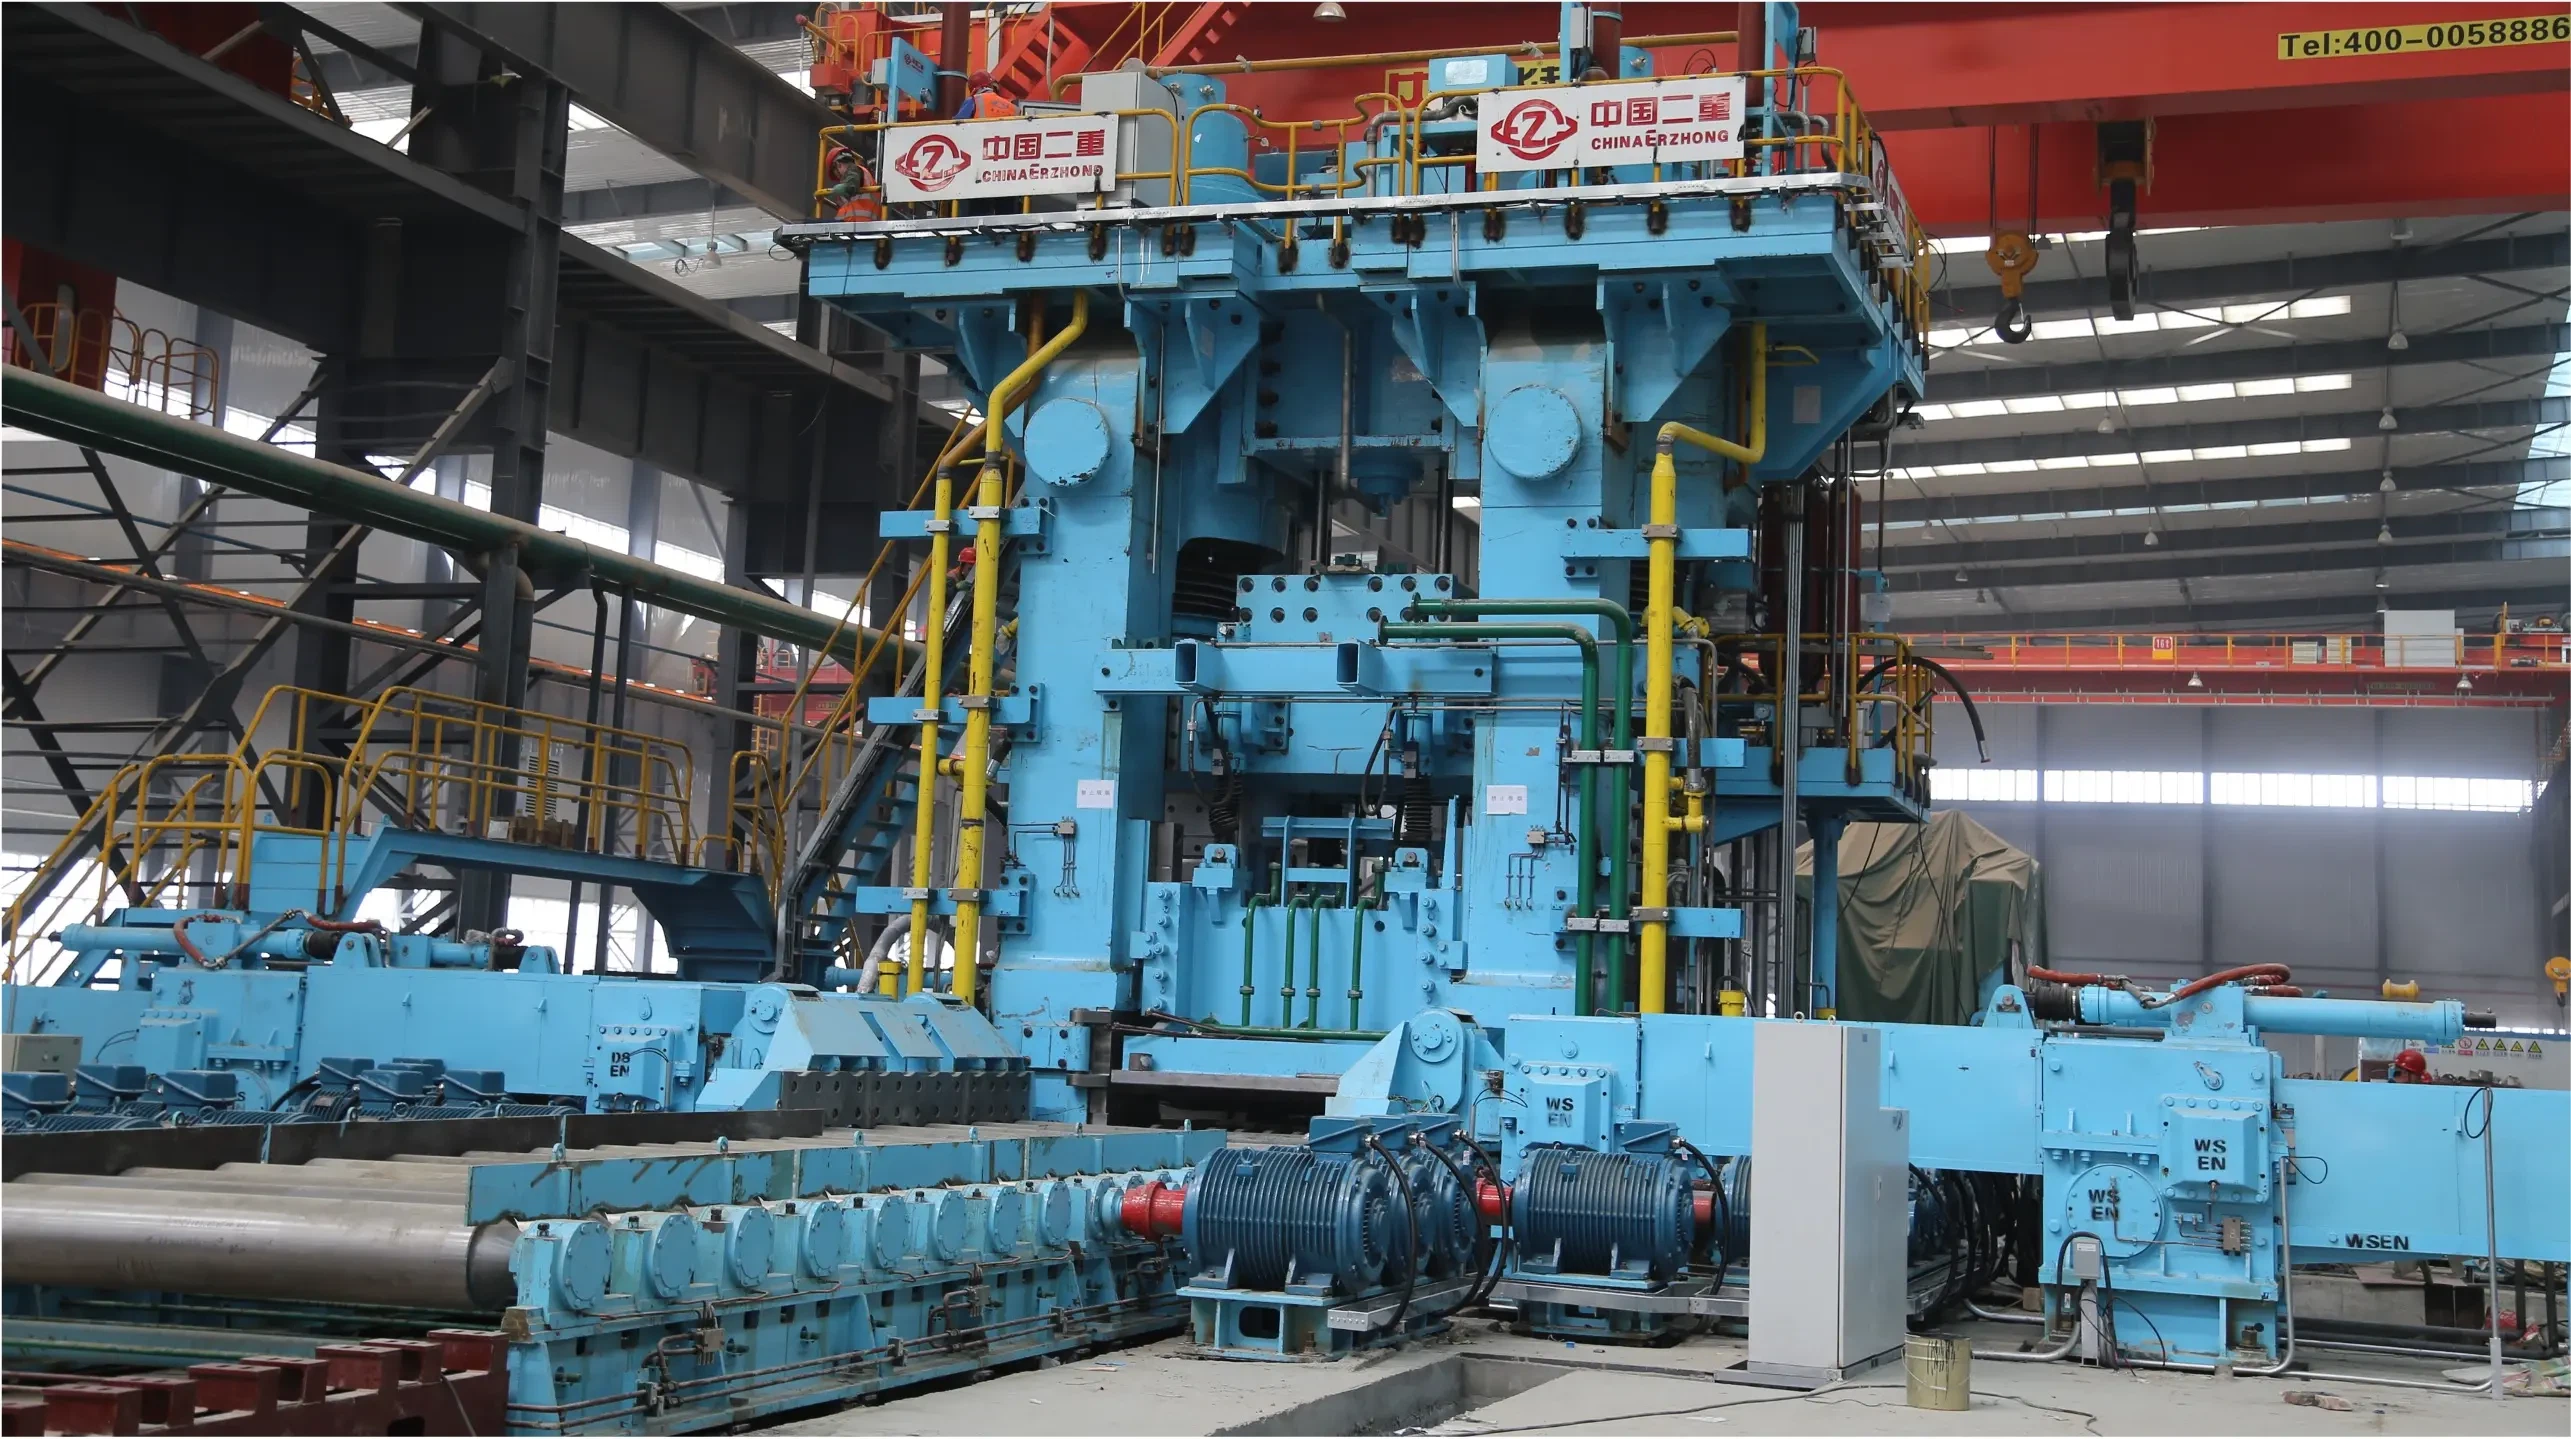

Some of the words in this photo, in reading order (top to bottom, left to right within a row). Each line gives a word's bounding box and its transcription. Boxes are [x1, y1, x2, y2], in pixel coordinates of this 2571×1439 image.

[1591, 91, 1730, 128] 中国二重
[982, 129, 1105, 162] 中国二重
[610, 1065, 630, 1077] EN
[1546, 1097, 1574, 1111] WS
[2194, 1138, 2226, 1153] WS
[2198, 1156, 2226, 1170] EN
[2088, 1189, 2120, 1204] WS
[2091, 1206, 2119, 1221] EN
[2345, 1233, 2409, 1250] WSEN
